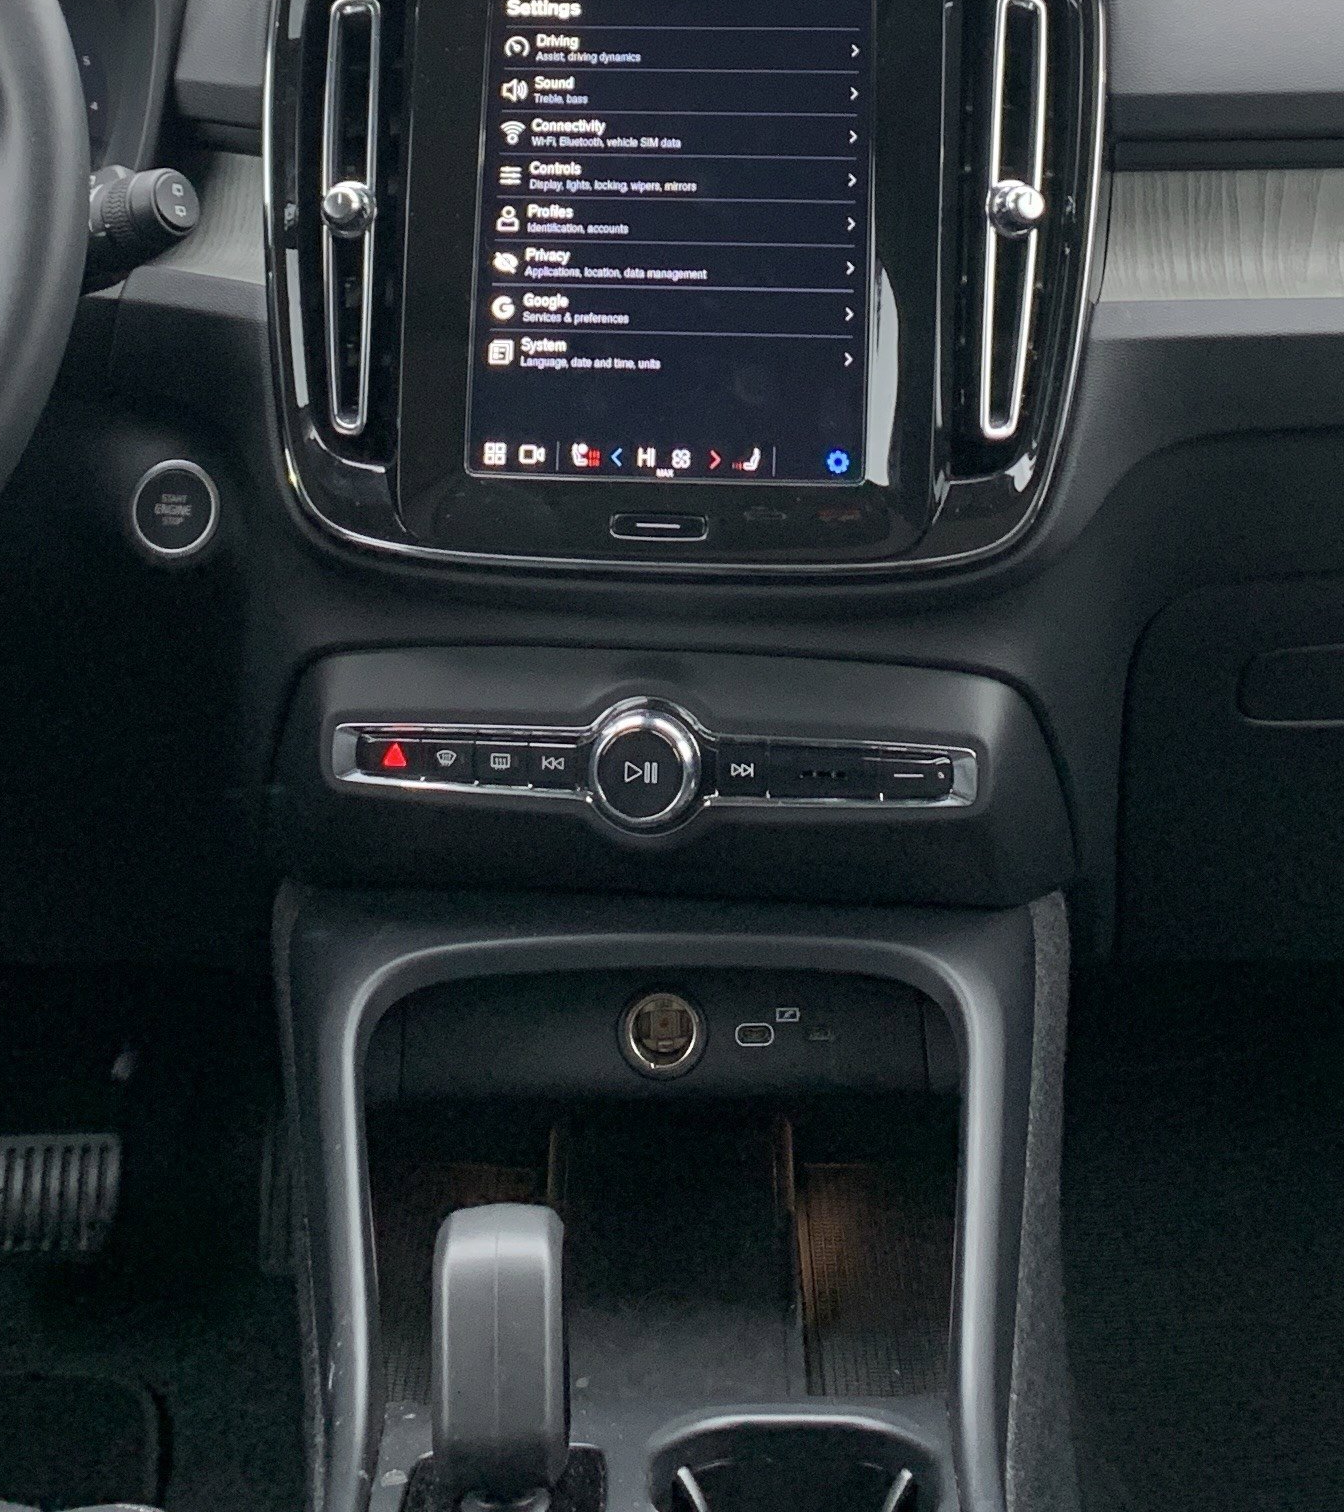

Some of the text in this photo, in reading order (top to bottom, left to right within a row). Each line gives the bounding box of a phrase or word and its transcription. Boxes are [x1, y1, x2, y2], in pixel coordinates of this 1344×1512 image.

[536, 34, 579, 51] Driving
[568, 52, 598, 64] driving
[599, 52, 641, 64] dynamics
[534, 76, 575, 90] Sound
[567, 94, 588, 104] bass
[531, 118, 606, 136] Connectivity
[606, 137, 638, 148] vehicle
[640, 137, 659, 148] SIM
[660, 138, 682, 149] data
[529, 160, 582, 176] Controls
[664, 181, 698, 192] mirrors
[527, 203, 574, 219] Profiles
[587, 224, 630, 234] accounts
[524, 247, 571, 265] Privacy
[623, 268, 645, 279] data
[646, 269, 708, 281] management
[523, 292, 570, 311] Google
[522, 311, 630, 326] Services & preferences
[520, 336, 568, 355] System
[571, 356, 592, 368] date
[594, 357, 612, 369] and
[638, 358, 661, 369] units
[637, 446, 656, 468] HI
